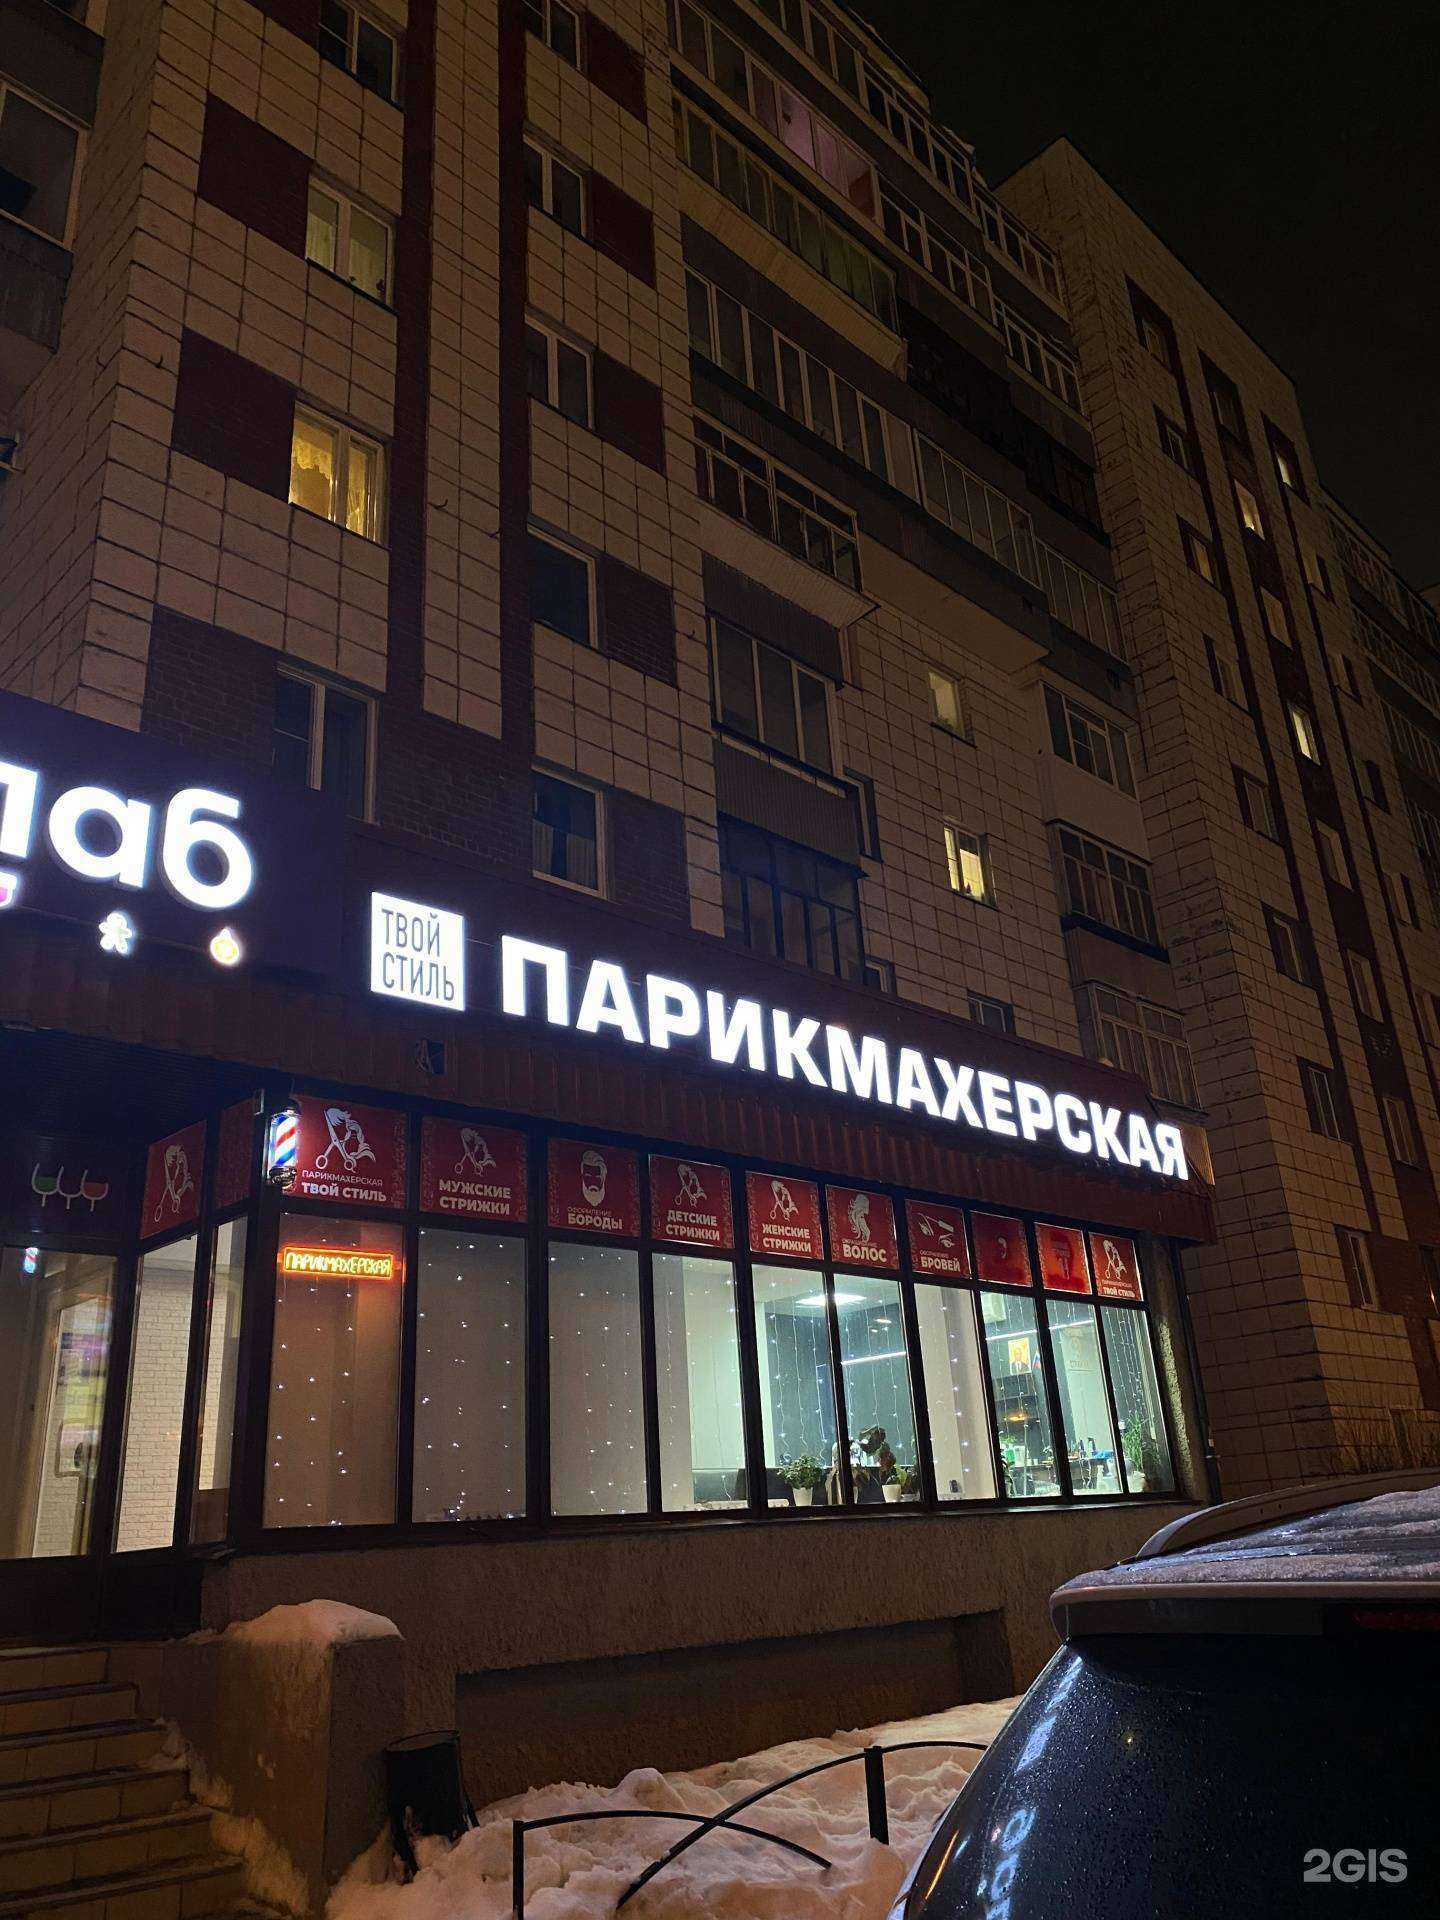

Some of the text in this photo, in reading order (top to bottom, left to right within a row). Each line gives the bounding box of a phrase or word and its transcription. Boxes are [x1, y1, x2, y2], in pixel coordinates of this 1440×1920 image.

[381, 908, 440, 957] ТВОЙ
[382, 952, 455, 1001] СТИЛЬ
[501, 935, 1189, 1181] ПАРИКМАХЕРСКАЯ
[301, 1169, 383, 1187] ПАРИКМАХЕРСКАЯ
[301, 1181, 387, 1202] ТВОЙ СТИЛЬ
[439, 1179, 512, 1199] МУЖСКИЕ
[439, 1196, 510, 1216] СТРИЖКИ
[568, 1213, 623, 1230] БОРОДЫ
[667, 1209, 718, 1226] ДЕТСКИЕ
[666, 1224, 720, 1241] СТРИЖКИ
[762, 1224, 811, 1239] ЖЕНСКИЕ
[763, 1237, 811, 1253] СТРИЖКИ
[843, 1244, 887, 1263] ВОЛОС
[285, 1252, 391, 1275] ПАРИКМАХЕРСКАЯ
[921, 1257, 961, 1273] БРОВЕЙ
